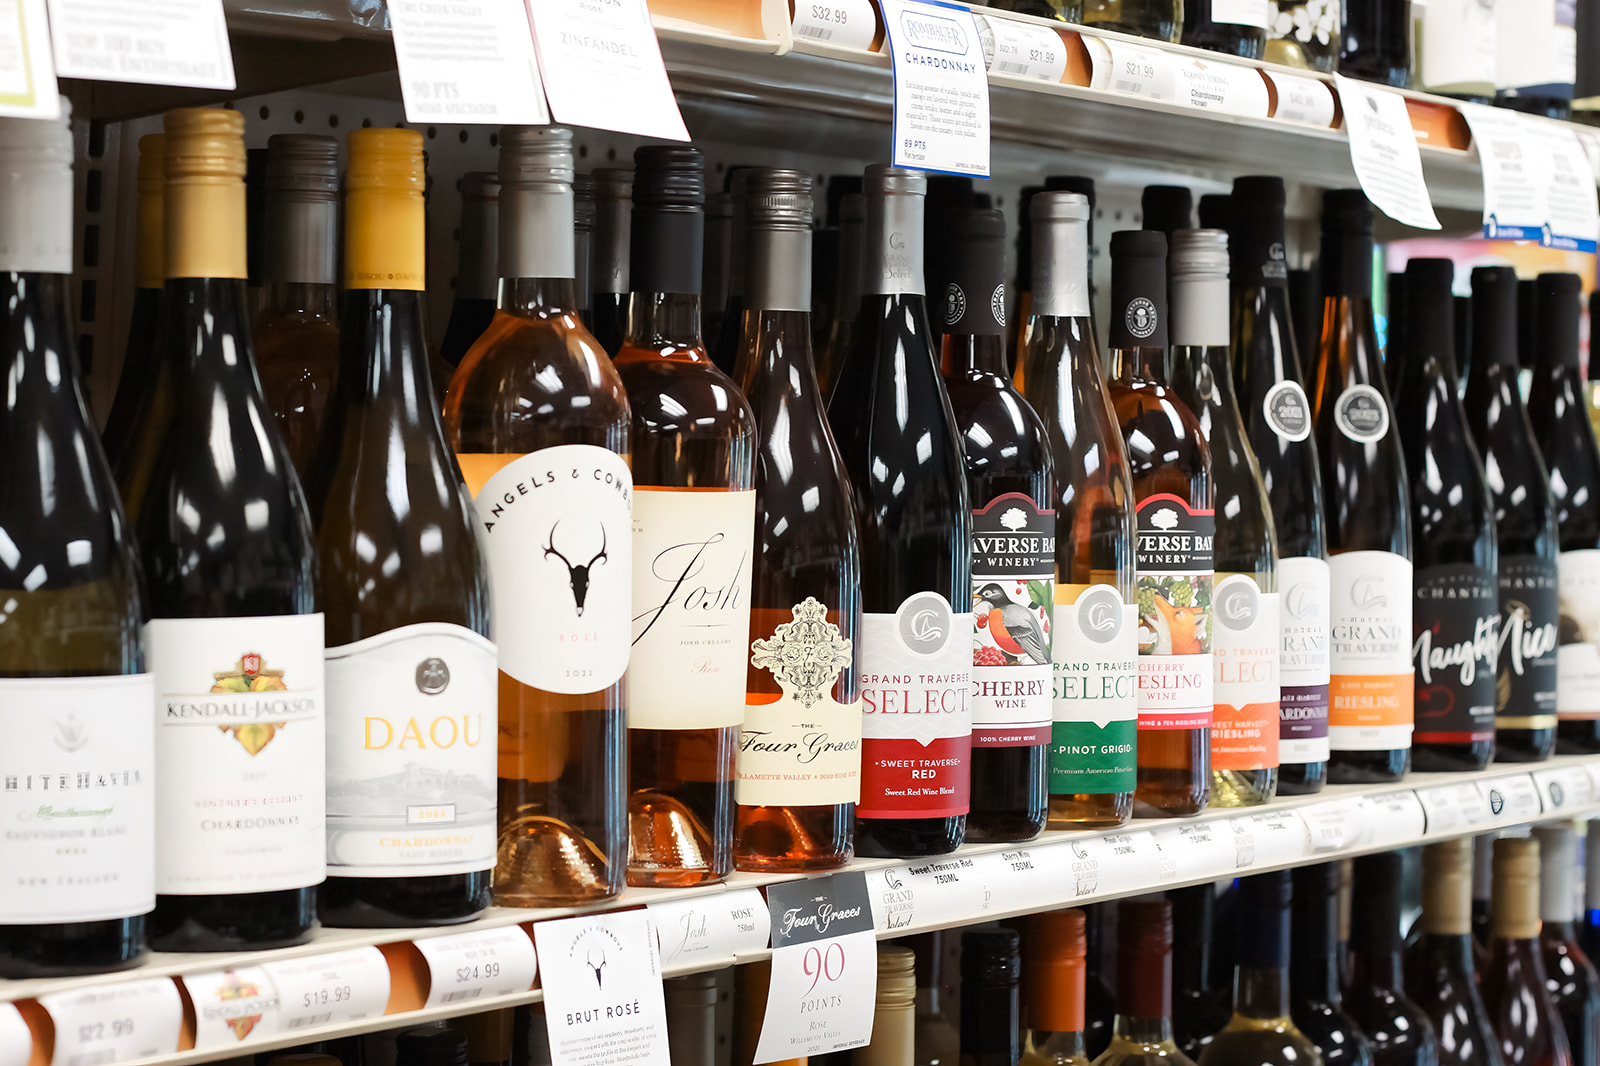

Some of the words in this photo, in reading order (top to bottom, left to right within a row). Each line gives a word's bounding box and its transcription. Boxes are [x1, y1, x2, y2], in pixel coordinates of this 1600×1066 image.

[812, 5, 848, 25] $32.99
[907, 19, 963, 48] ROMBAUER
[560, 31, 638, 57] ZINFANDEL
[905, 52, 976, 74] CHARDONNAY
[1029, 49, 1055, 64] $21.99
[1126, 61, 1154, 79] $21.99
[411, 80, 430, 98] 90
[433, 82, 460, 99] PTS
[1190, 88, 1224, 104] Chardonnay
[914, 140, 926, 150] PTS
[484, 471, 555, 533] ANGELS
[987, 558, 1036, 566] WINERY
[1138, 555, 1187, 563] WINERY
[632, 532, 747, 648] Josh
[1138, 664, 1184, 672] CHERRY
[861, 674, 912, 684] GRAND
[919, 673, 969, 684] TRAVERSE
[861, 688, 968, 714] SELECT
[994, 699, 1026, 708] WINE
[1146, 692, 1177, 700] WINE
[1334, 696, 1399, 709] RIESLING
[166, 698, 316, 719] KENDALL-JACKSON
[364, 713, 482, 750] DAOU
[1212, 729, 1261, 738] RIESLING
[741, 730, 797, 752] Four
[1059, 746, 1096, 754] PINOT
[1101, 744, 1131, 753] GRIGIO
[912, 769, 936, 779] RED
[885, 788, 905, 796] Sweet
[939, 786, 955, 795] Blend
[200, 815, 300, 832] CHARDONNAY
[380, 834, 475, 847] CHARDONNAY
[1189, 836, 1212, 845] 750ML
[1002, 852, 1018, 862] Cherry
[1114, 846, 1135, 856] 750ML
[908, 865, 931, 876] Sweet
[932, 862, 960, 873] Traverse
[960, 859, 974, 869] Red
[1010, 861, 1034, 872] 750ML
[1072, 859, 1098, 872] GRAND
[934, 874, 959, 885] 750ML
[882, 889, 914, 905] GRAND
[883, 903, 914, 914] TRAVERSE
[737, 922, 755, 933] 750ml
[780, 907, 817, 938] Four
[814, 904, 861, 934] Graces
[667, 910, 709, 964] Josh
[456, 962, 500, 983] $24.99
[801, 943, 846, 1000] 90
[303, 986, 352, 1008] $19.99
[800, 995, 842, 1014] POINTS
[567, 1009, 599, 1026] BRUT
[606, 998, 640, 1019] ROSÉ
